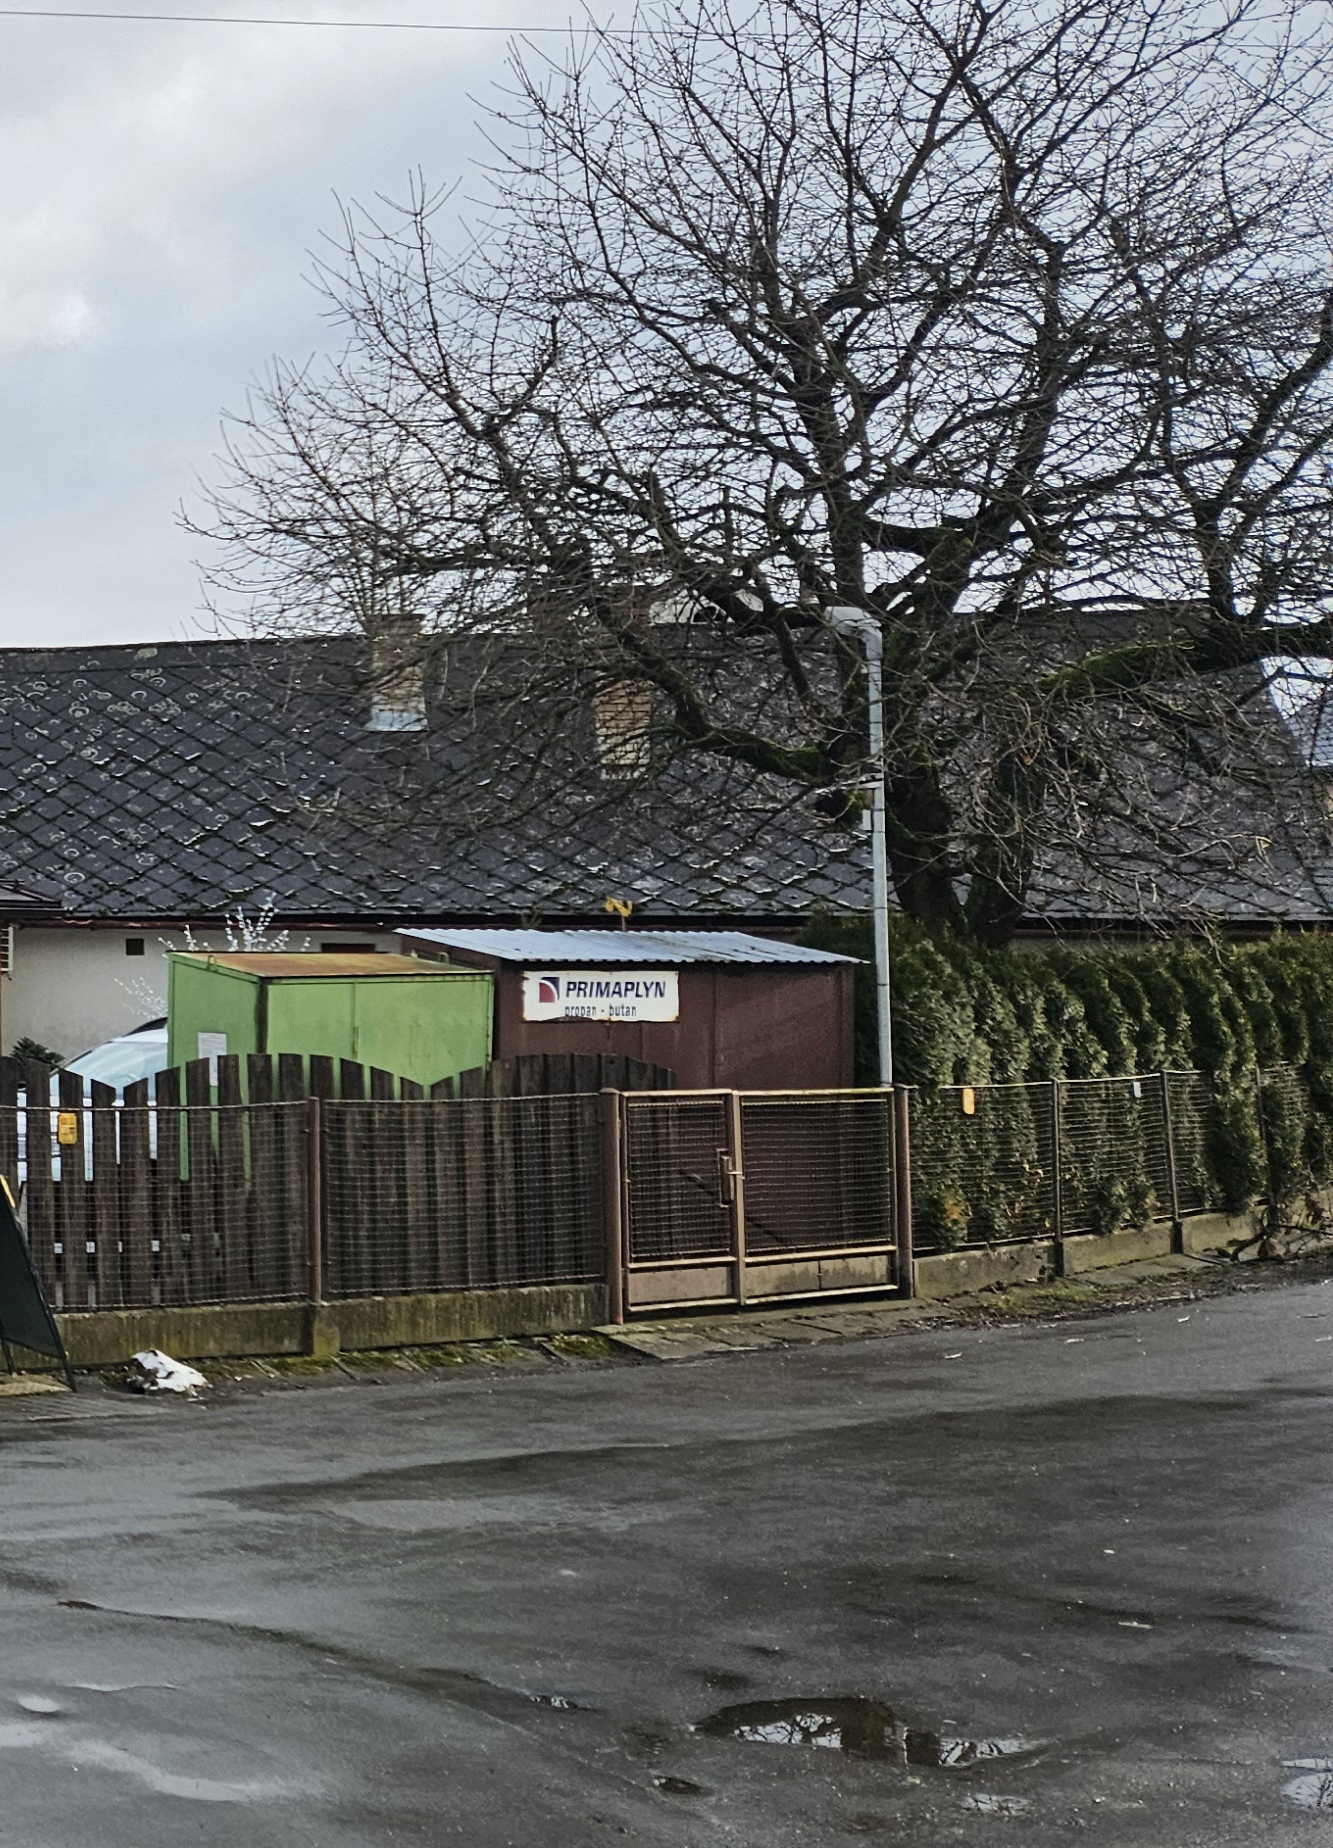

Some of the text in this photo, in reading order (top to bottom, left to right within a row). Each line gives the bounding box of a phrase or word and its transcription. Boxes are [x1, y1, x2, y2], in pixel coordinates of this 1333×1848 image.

[566, 981, 666, 998] PRIMAPLYN
[564, 1005, 597, 1017] propan
[609, 1004, 637, 1017] butan
